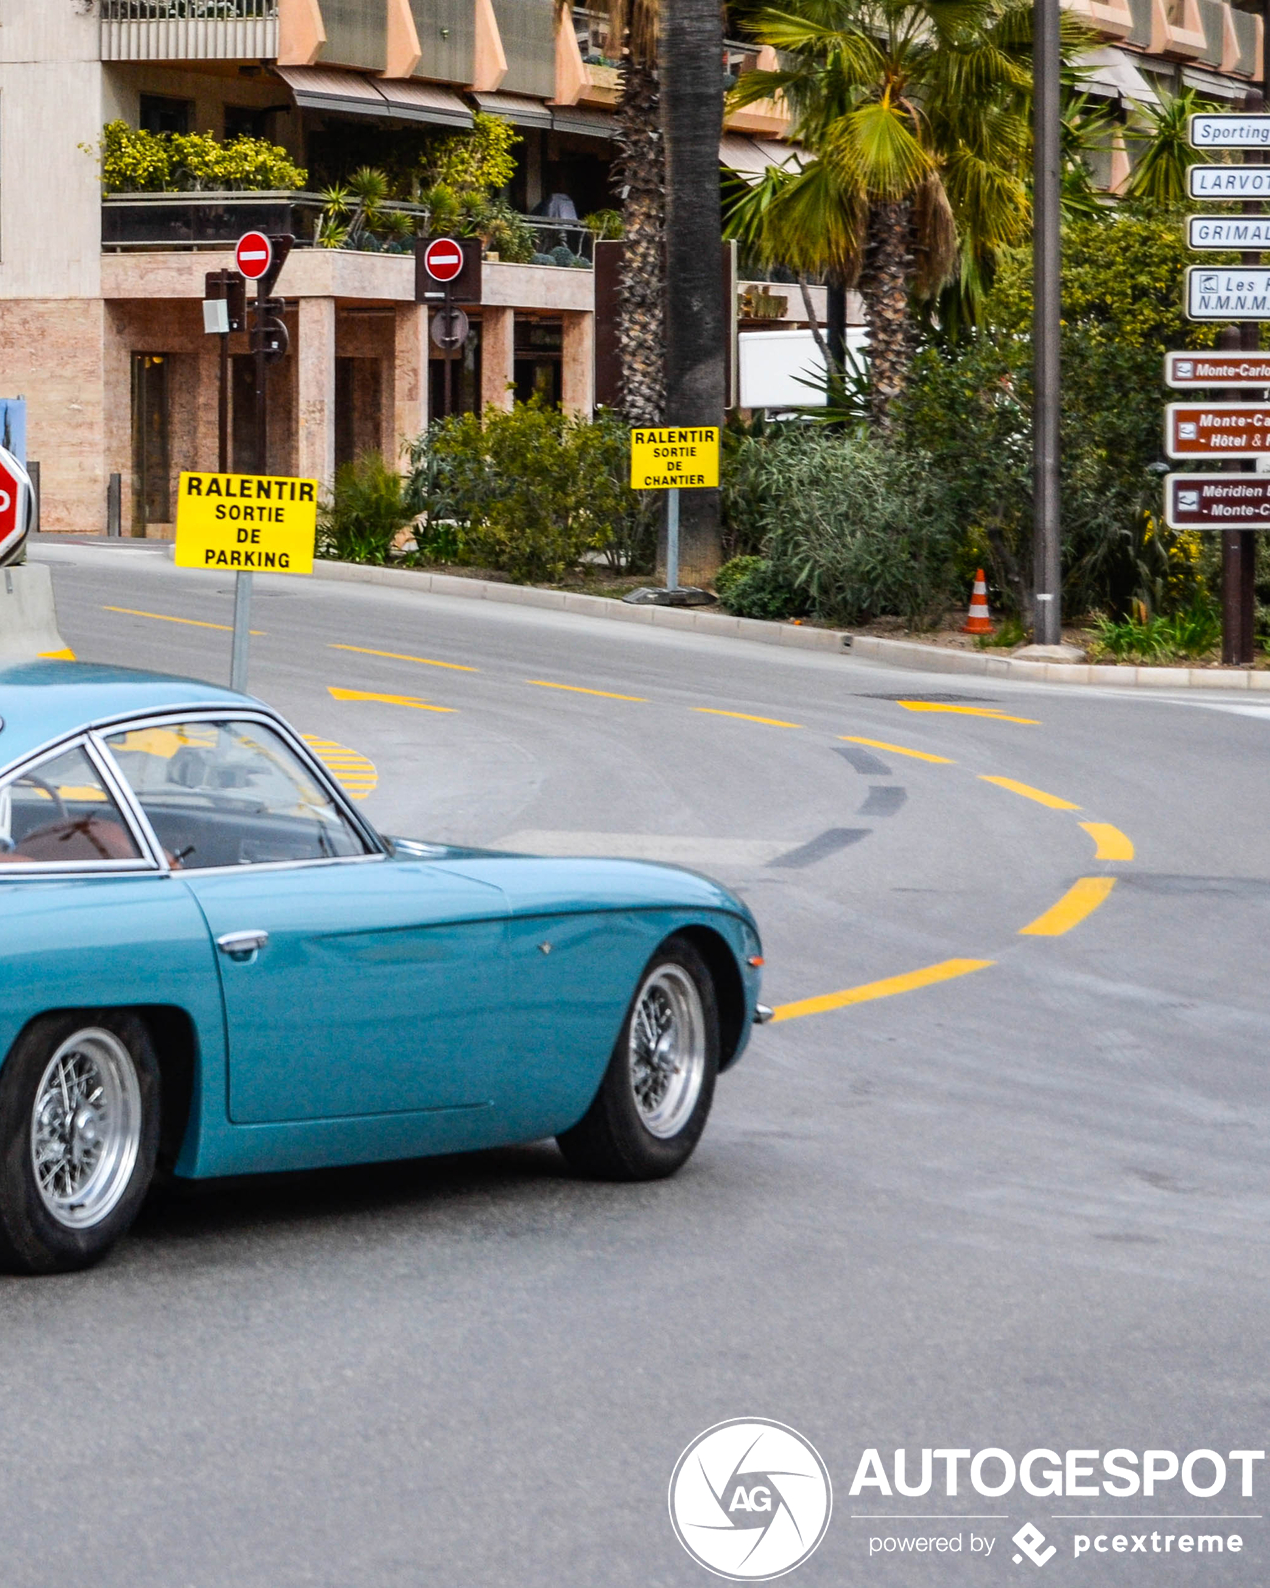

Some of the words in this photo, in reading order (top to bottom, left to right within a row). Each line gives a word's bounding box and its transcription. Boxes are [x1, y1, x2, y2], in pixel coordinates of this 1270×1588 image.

[1201, 124, 1269, 142] Sporting
[1199, 226, 1270, 240] GRIMAL
[1226, 277, 1255, 292] Les
[1196, 363, 1270, 377] Monte-Carlo
[635, 430, 714, 445] RALENTIR
[1210, 433, 1247, 447] Hôtel
[1251, 433, 1262, 447] &
[653, 446, 697, 458] SORTIE
[667, 461, 683, 472] DE
[644, 474, 705, 486] CHANTIER
[187, 476, 315, 502] RALENTIR
[1202, 485, 1263, 498] Méridien
[215, 504, 286, 523] SORTIE
[236, 527, 261, 544] DE
[205, 549, 290, 569] PARKING
